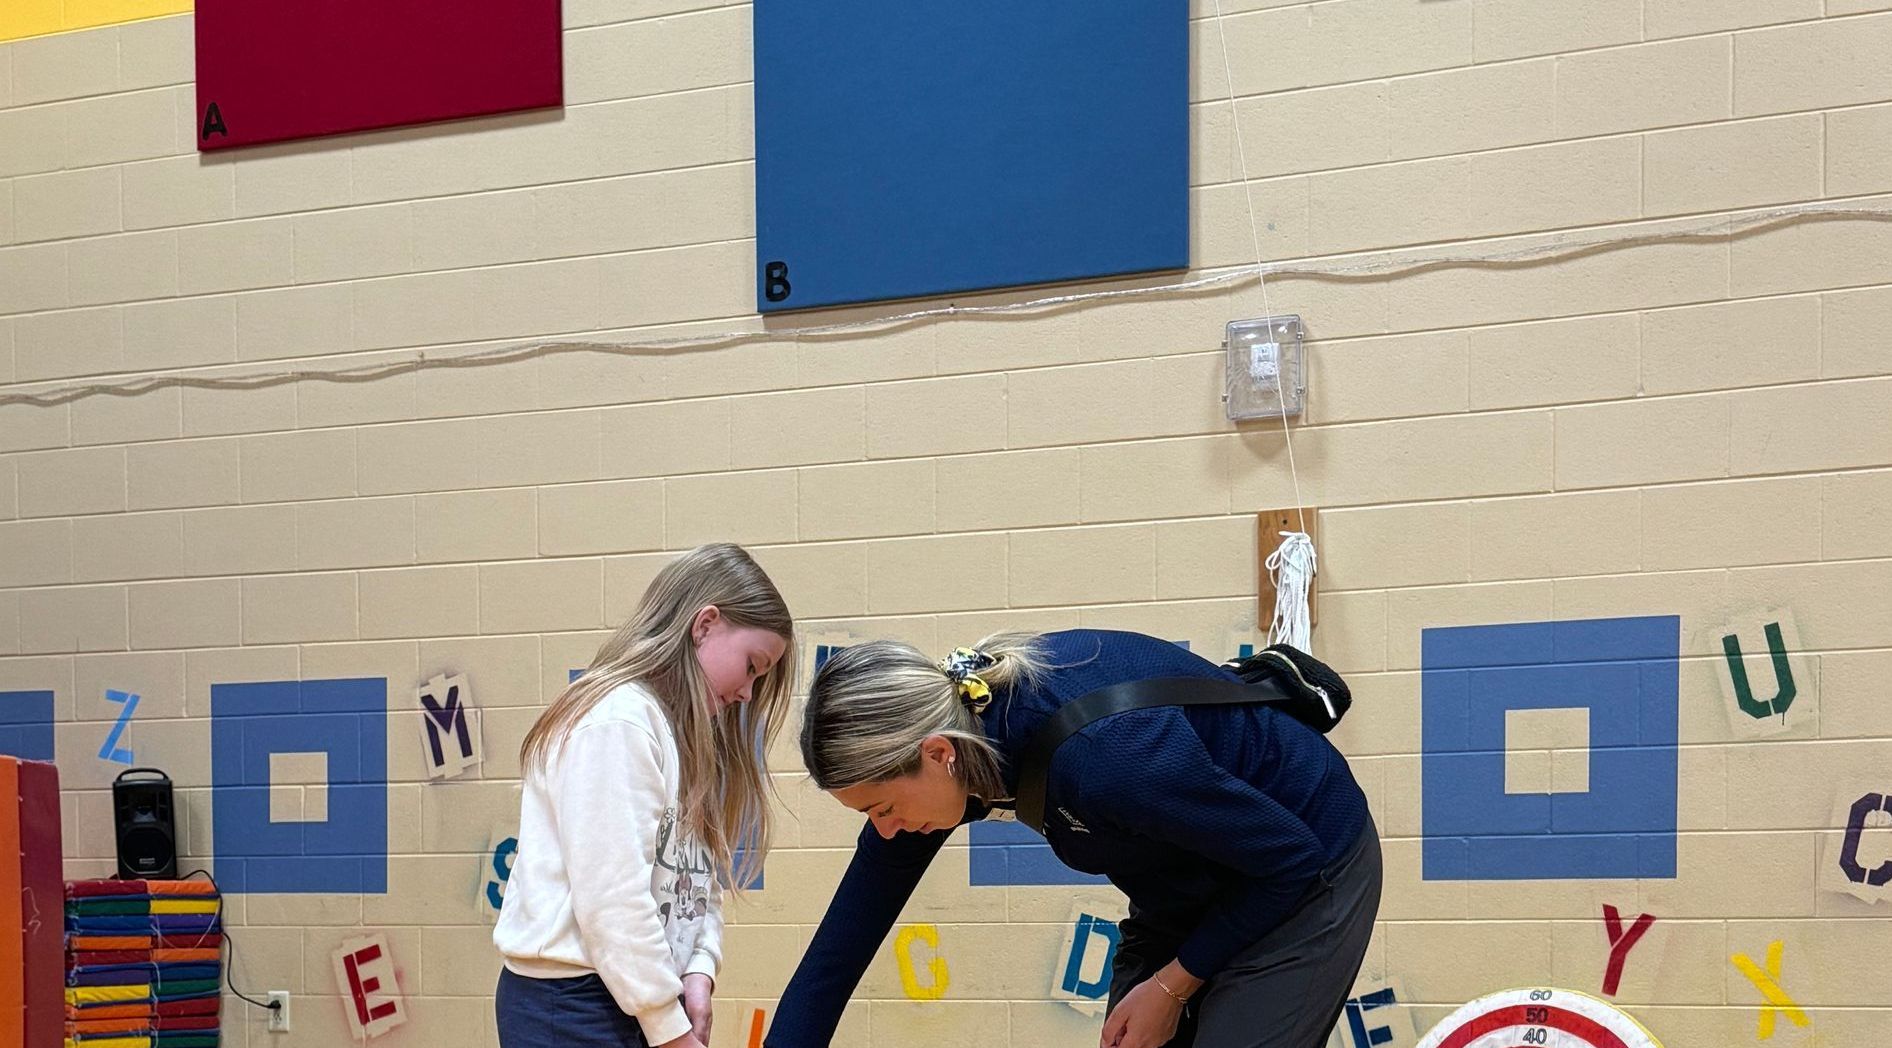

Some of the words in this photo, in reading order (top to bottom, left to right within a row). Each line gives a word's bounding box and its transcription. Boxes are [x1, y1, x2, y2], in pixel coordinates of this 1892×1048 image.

[201, 102, 228, 141] A
[764, 260, 791, 303] B
[1722, 622, 1797, 726] U
[97, 689, 141, 766] Z
[420, 684, 473, 769] M
[342, 943, 397, 1026] E
[894, 923, 950, 1002] G
[1062, 912, 1120, 1000] D
[1602, 903, 1656, 997] Y
[1526, 1009, 1548, 1023] 50
[1529, 990, 1552, 1001] 60
[1731, 940, 1811, 1040] X
[1523, 1028, 1547, 1044] 40
